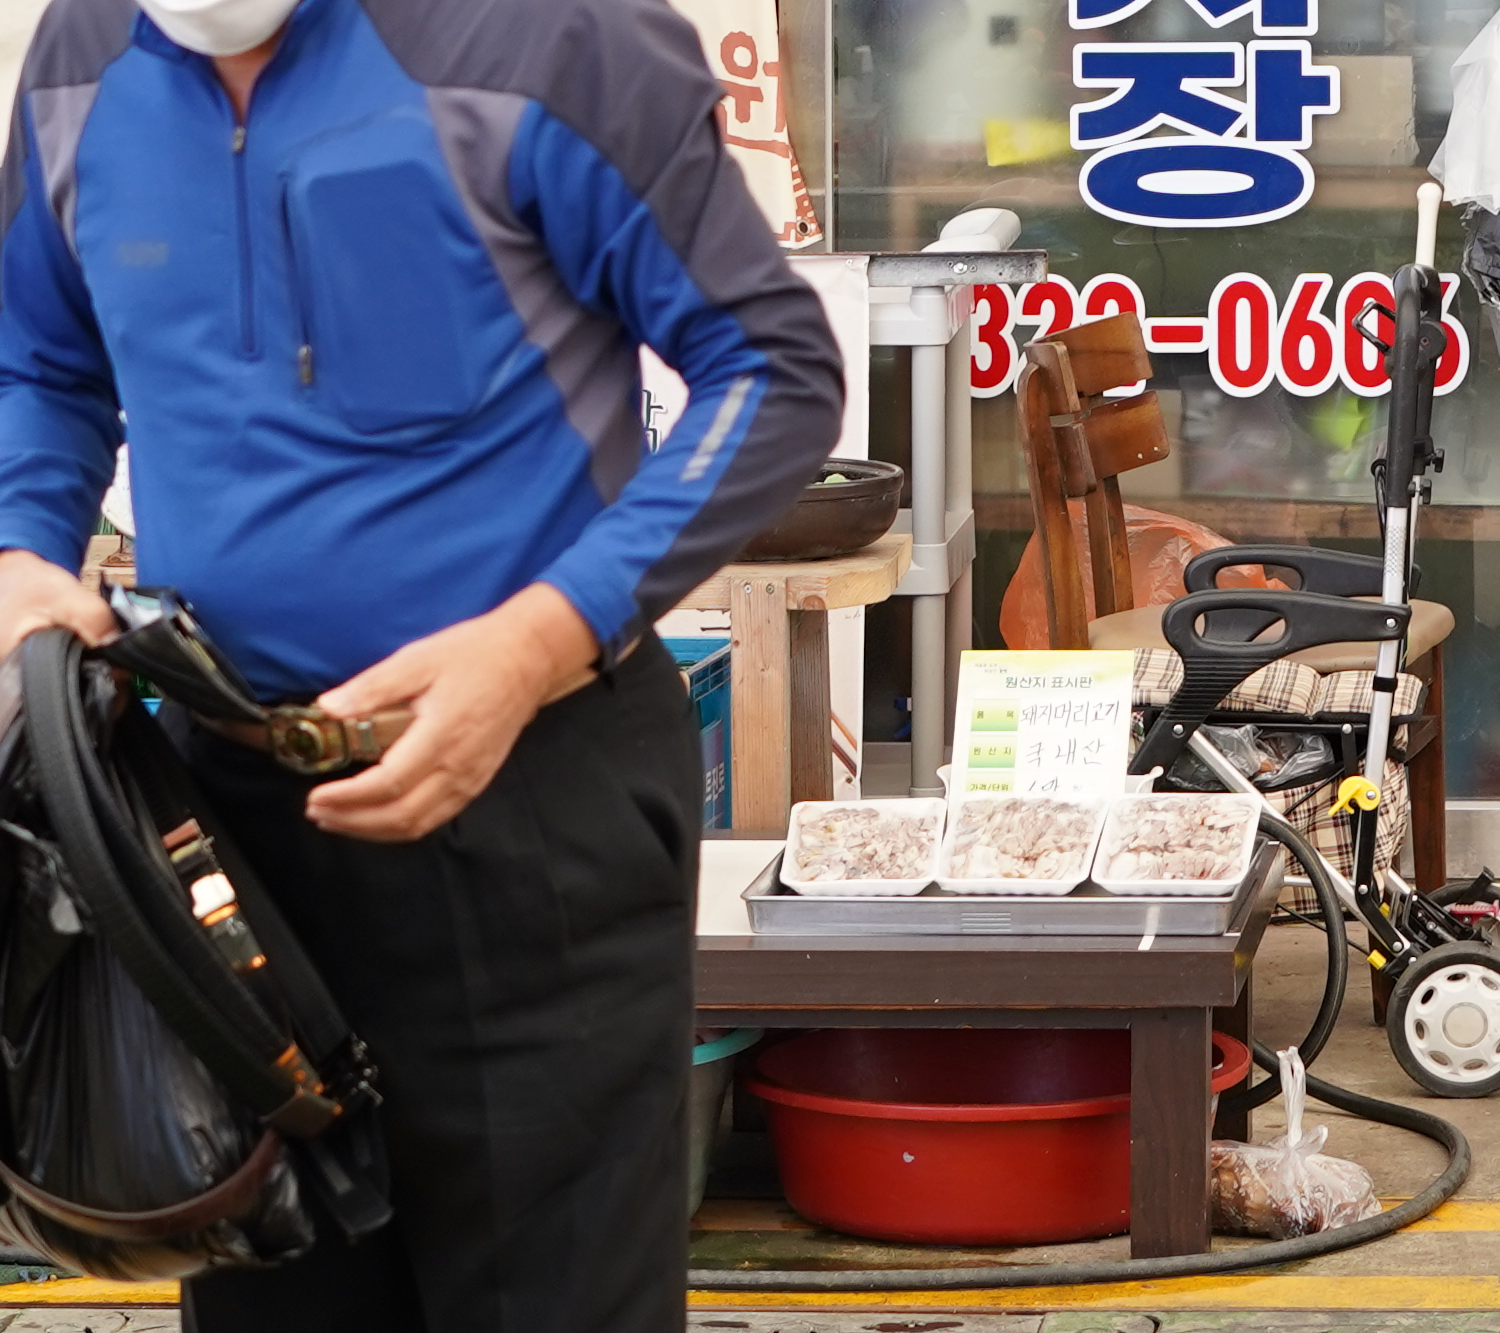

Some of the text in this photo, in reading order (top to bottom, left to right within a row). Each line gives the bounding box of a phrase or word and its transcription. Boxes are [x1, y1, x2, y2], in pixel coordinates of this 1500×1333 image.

[1005, 676, 1094, 689] 원산지 표시판
[1021, 700, 1121, 728] 돼지머리고기
